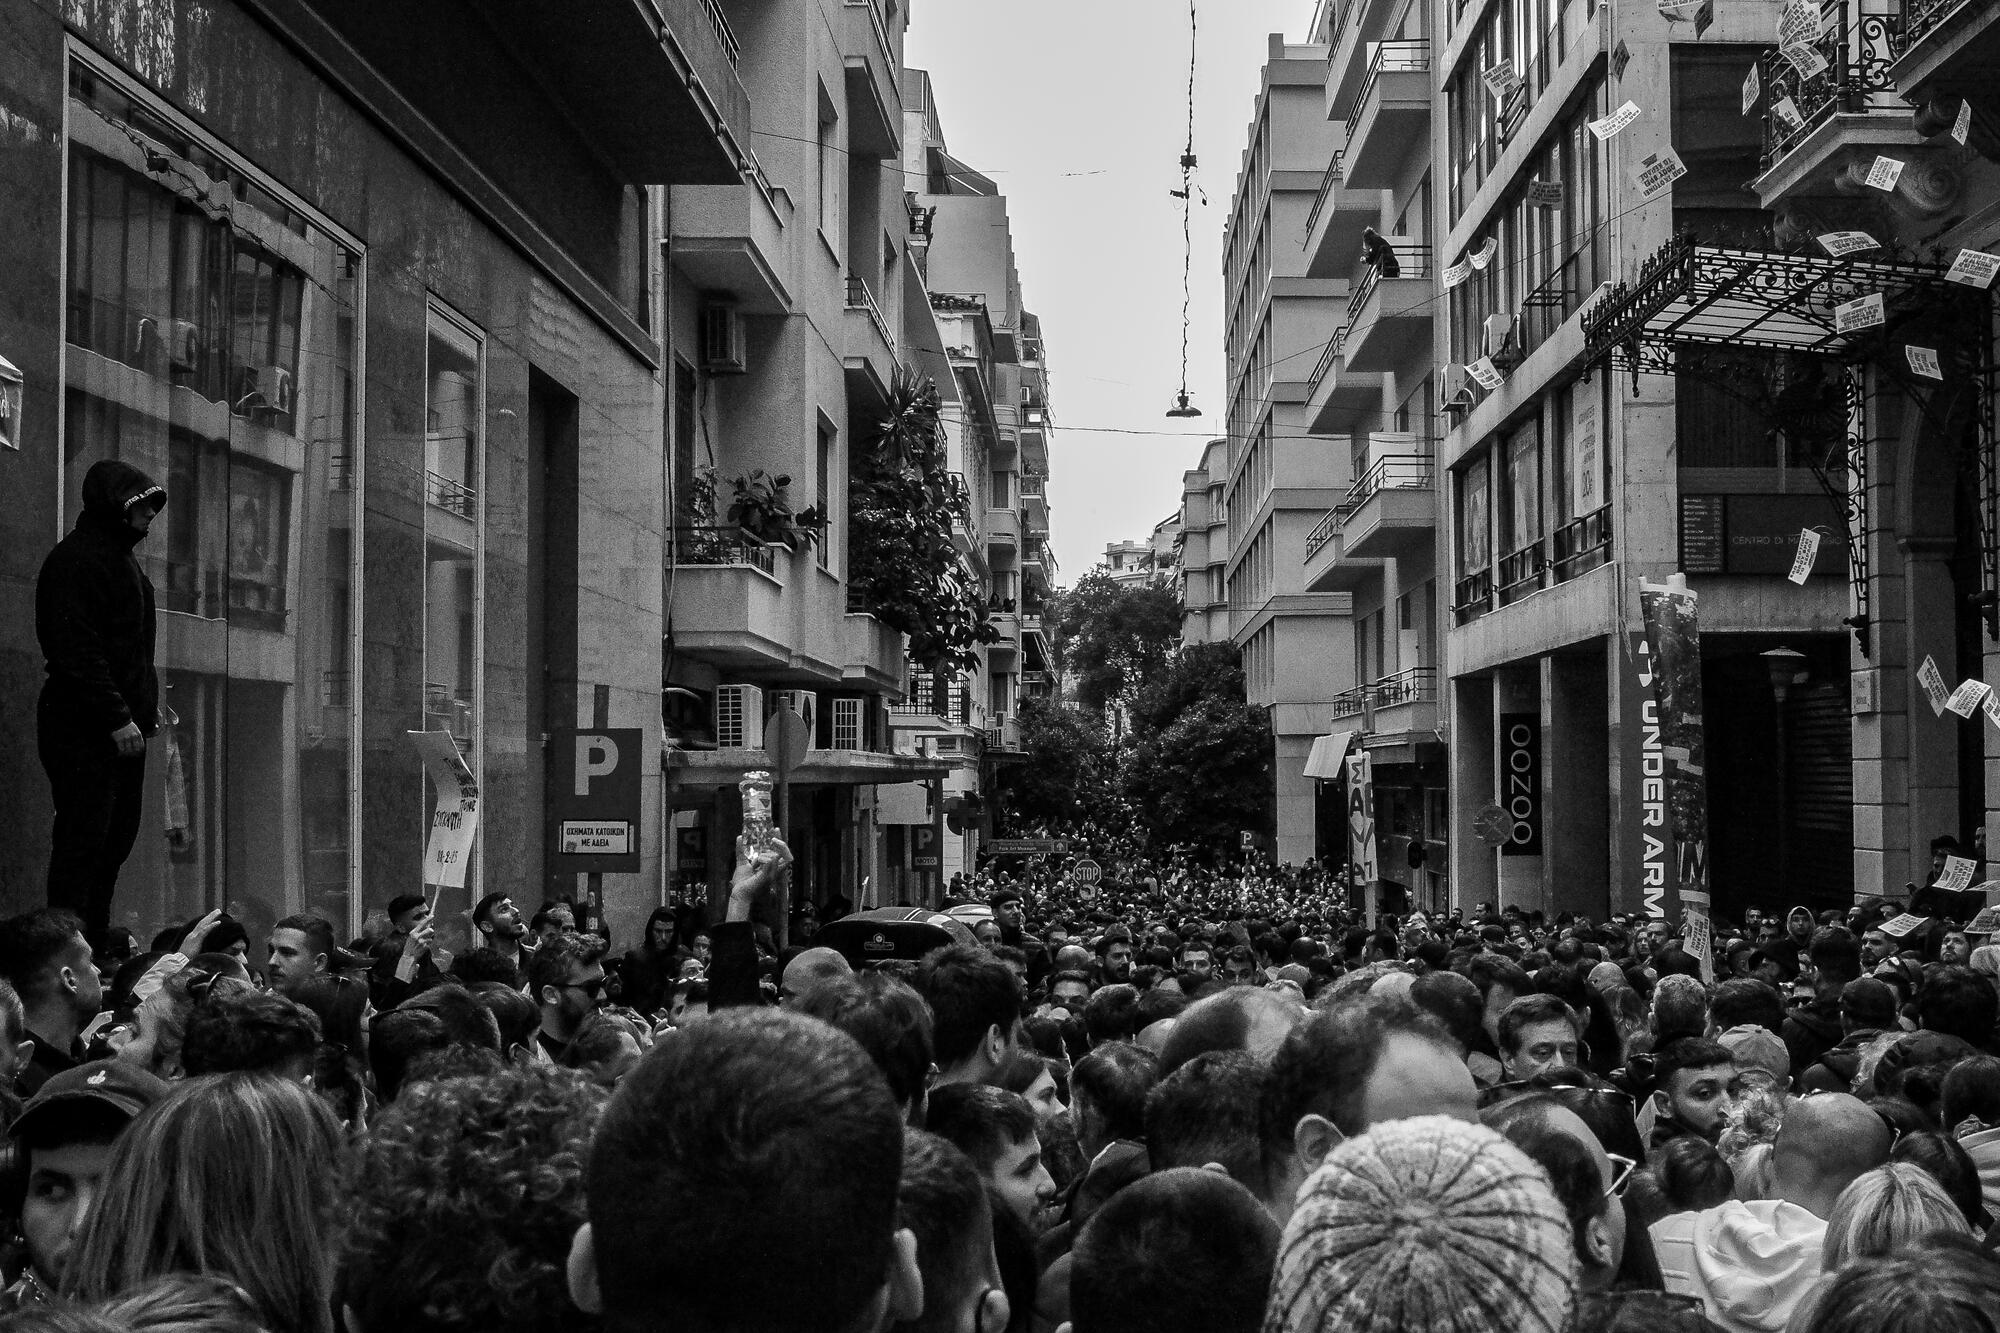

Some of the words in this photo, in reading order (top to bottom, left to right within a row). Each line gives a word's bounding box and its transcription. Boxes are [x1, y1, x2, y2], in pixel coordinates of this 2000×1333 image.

[1732, 535, 1770, 544] CENTRO
[1774, 535, 1783, 544] DI
[574, 735, 618, 795] P
[1641, 699, 1664, 827] UNDER
[1510, 723, 1532, 844] OOZOO
[566, 827, 594, 836] ΟΧΗΜΑΤΑ
[595, 827, 624, 836] ΚΑΤΟΙΚΩΝ
[1243, 832, 1251, 844] P
[581, 838, 590, 847] ΜΕ
[591, 838, 609, 847] ΑΔΕΙΑ
[917, 828, 933, 850] P
[1075, 866, 1098, 880] STOP
